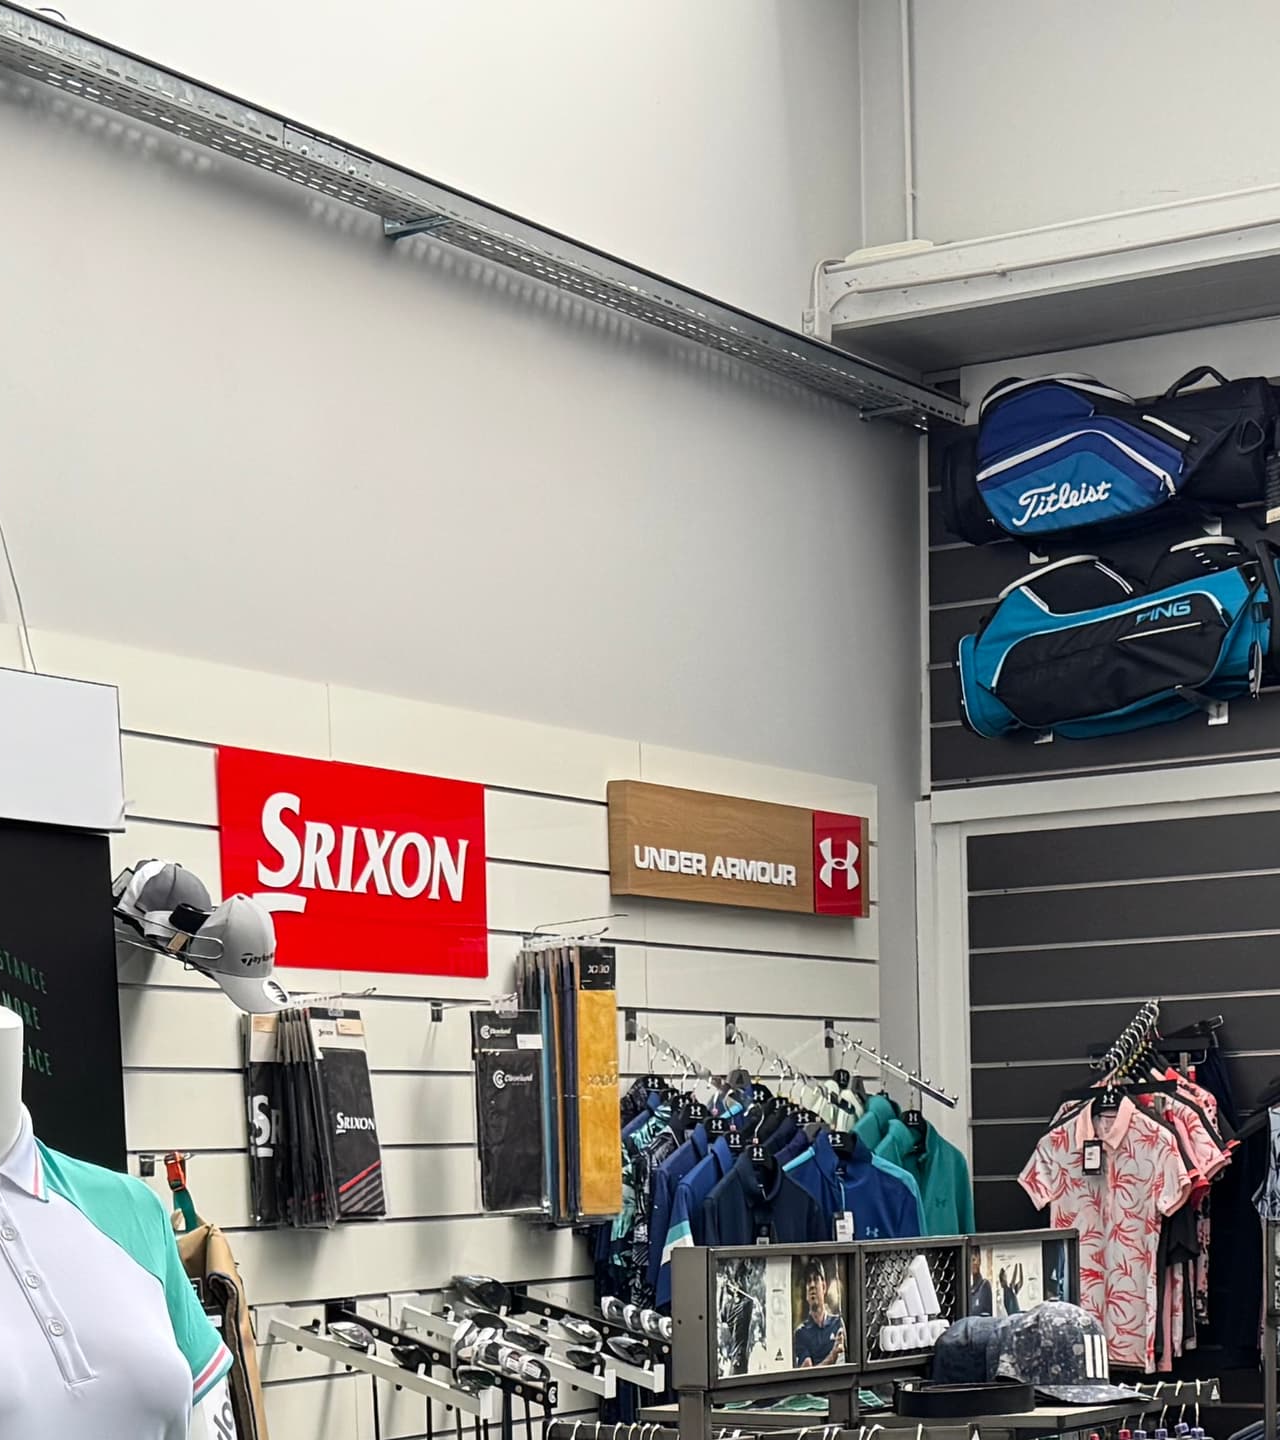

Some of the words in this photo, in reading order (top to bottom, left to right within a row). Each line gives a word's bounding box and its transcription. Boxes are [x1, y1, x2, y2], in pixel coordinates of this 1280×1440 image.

[1012, 480, 1112, 526] Titleist
[1135, 599, 1192, 625] PING
[257, 791, 469, 903] SRIXON
[634, 844, 707, 877] UNDER
[711, 856, 797, 887] ARMOUR
[22, 1044, 53, 1076] ACE
